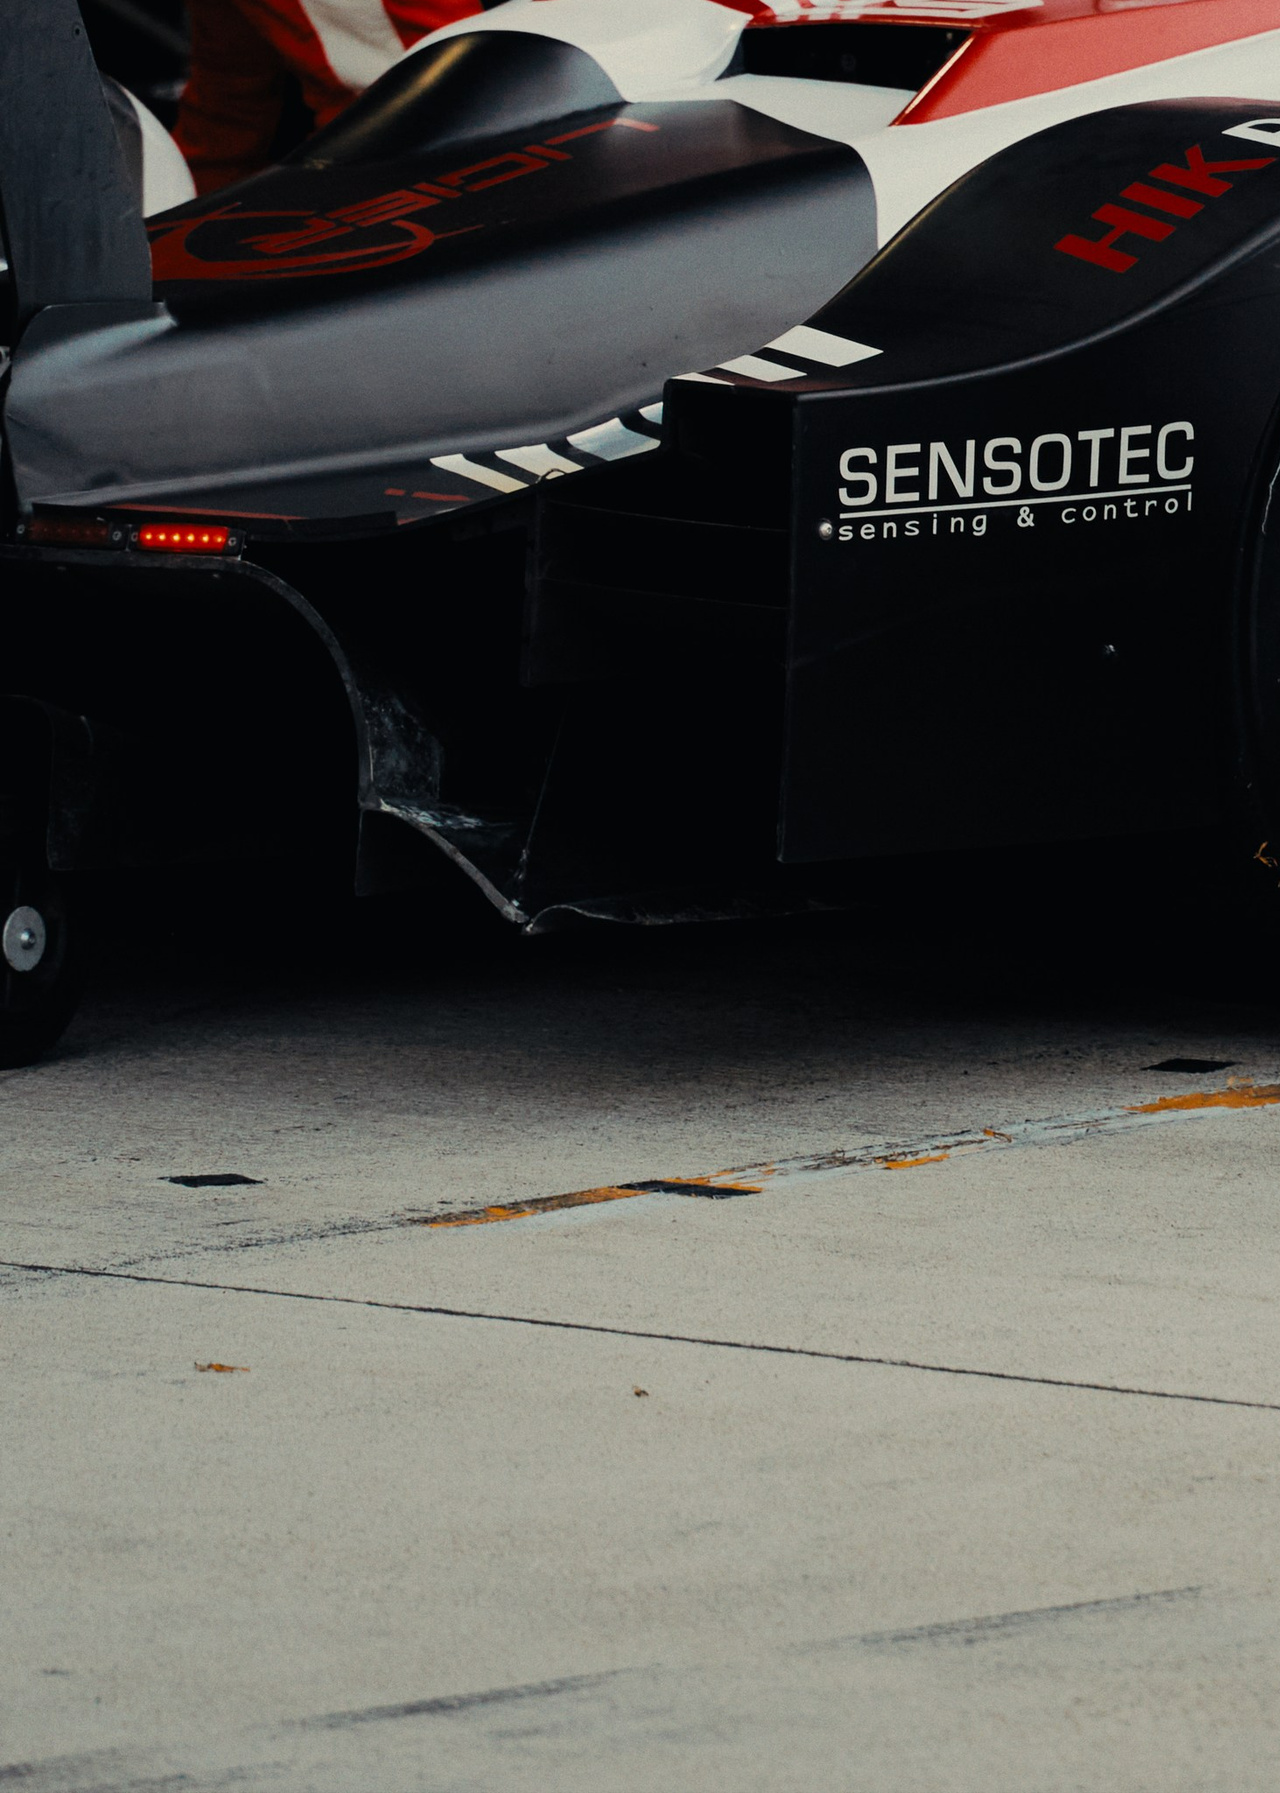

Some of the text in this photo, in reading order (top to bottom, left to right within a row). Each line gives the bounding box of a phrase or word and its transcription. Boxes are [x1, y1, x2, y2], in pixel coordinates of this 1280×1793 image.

[838, 420, 1195, 507] SENSOTEC
[838, 490, 1194, 542] sensing & control
